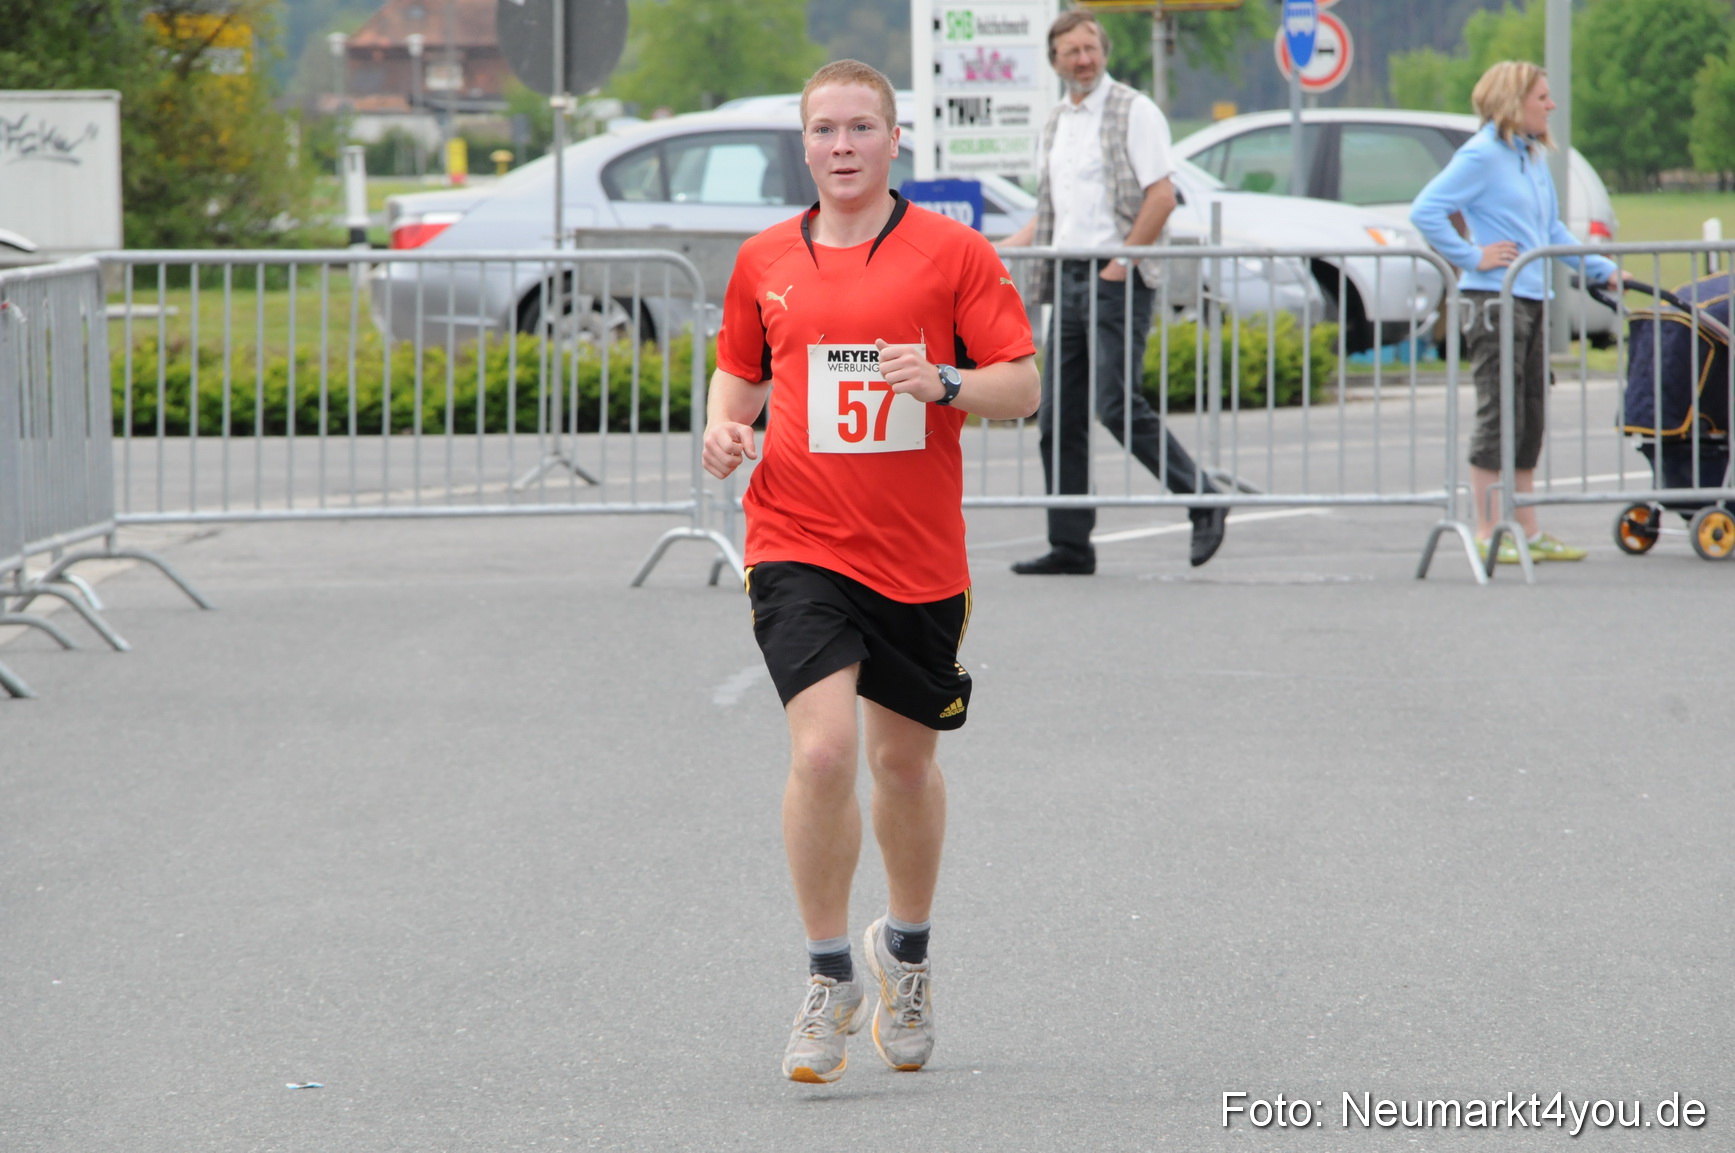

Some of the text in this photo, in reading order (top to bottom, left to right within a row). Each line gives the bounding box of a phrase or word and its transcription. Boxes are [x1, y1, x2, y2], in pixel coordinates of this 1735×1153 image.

[827, 350, 880, 362] MEYER
[827, 363, 880, 373] WERBUNG
[837, 381, 897, 443] 57
